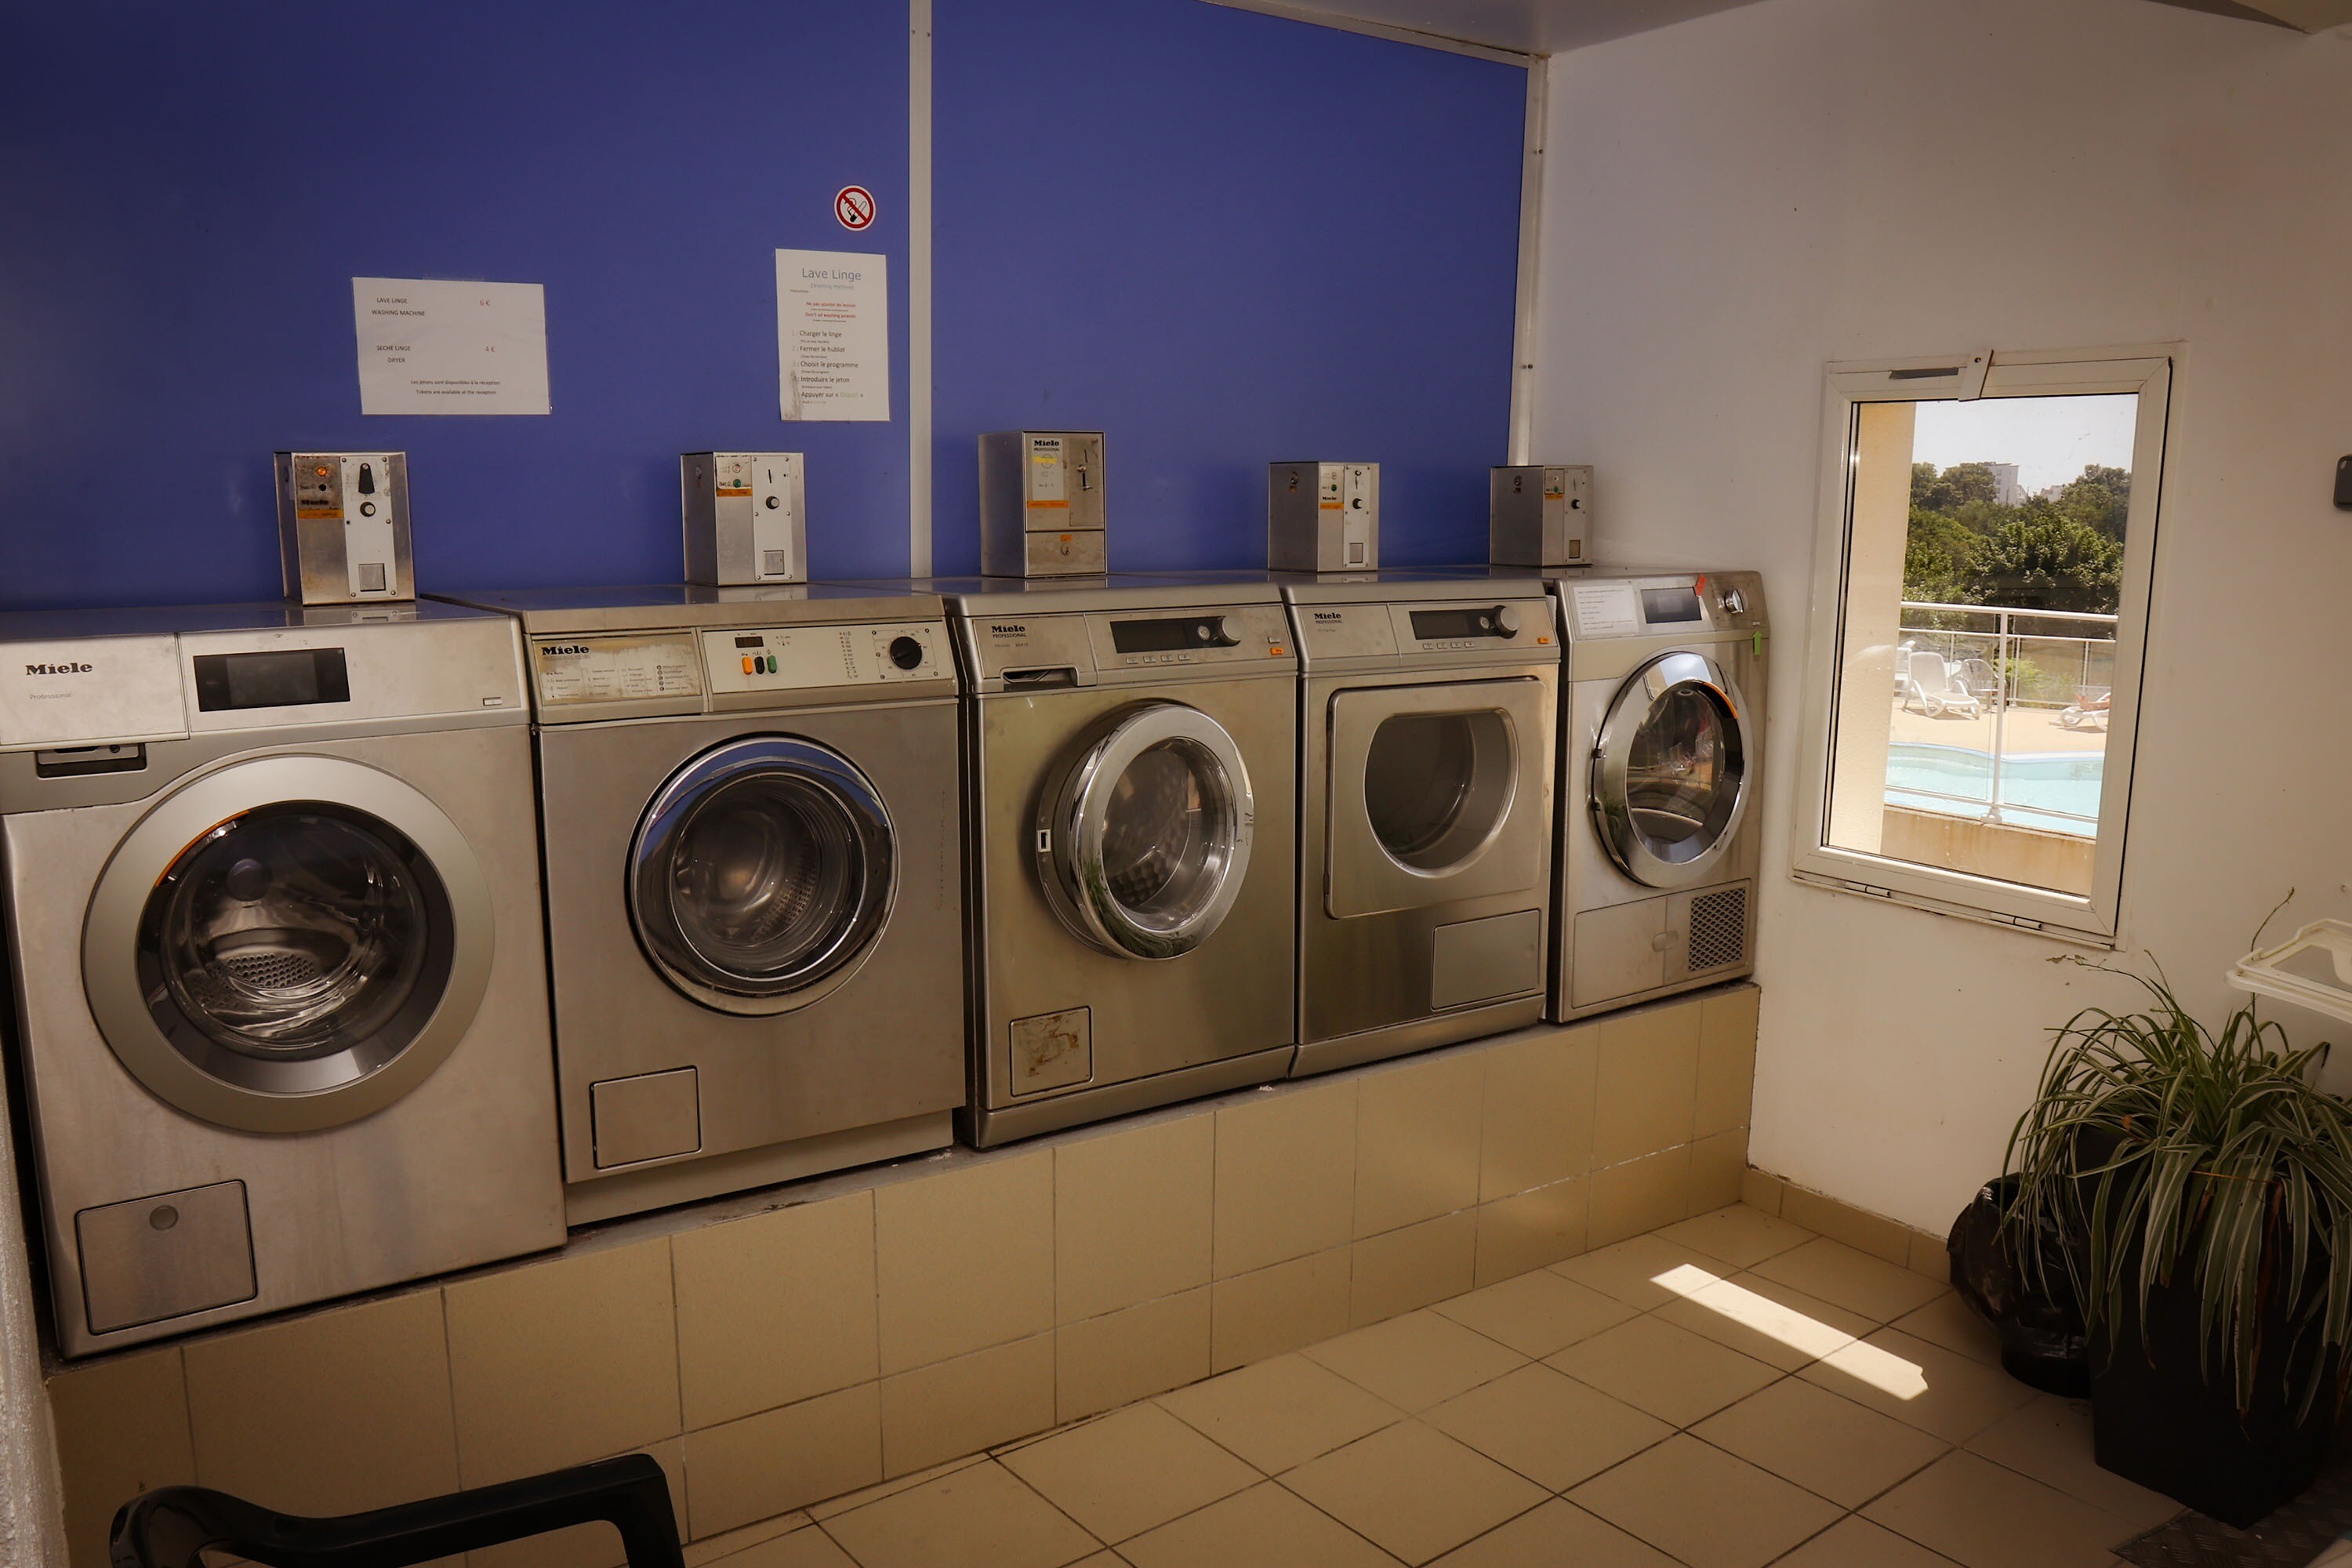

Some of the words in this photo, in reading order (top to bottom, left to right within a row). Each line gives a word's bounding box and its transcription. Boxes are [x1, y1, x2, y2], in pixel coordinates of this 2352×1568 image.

[802, 267, 828, 279] Lave
[832, 269, 862, 282] Linge
[991, 624, 1026, 633] Miele
[541, 645, 590, 656] Miele
[25, 662, 93, 676] Miele
[30, 691, 72, 701] Professional
